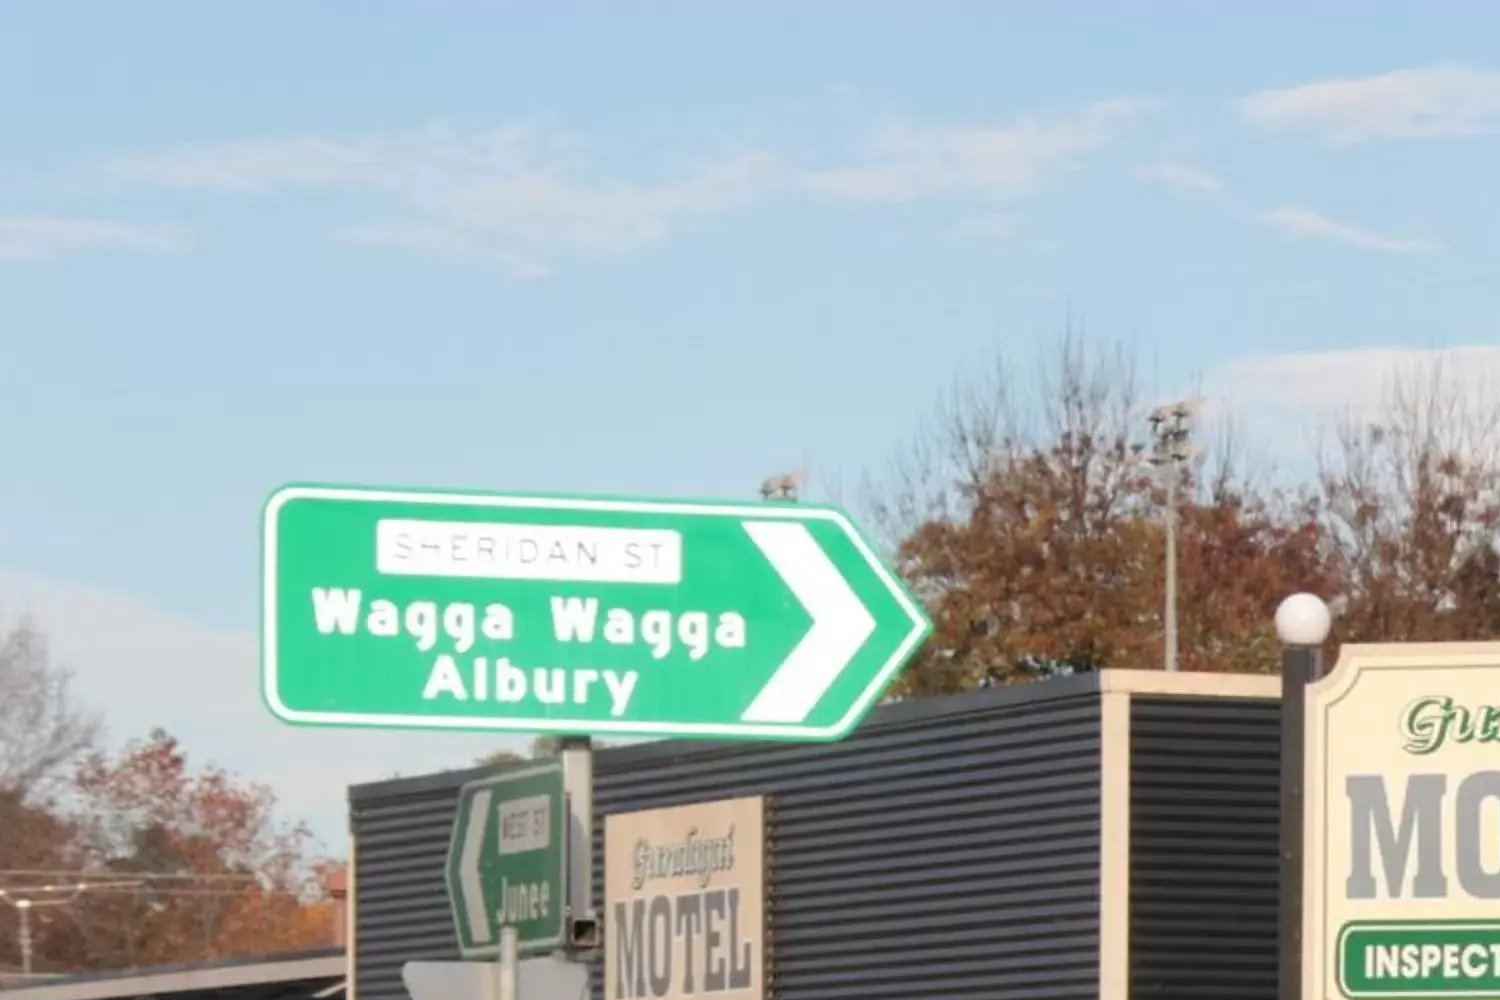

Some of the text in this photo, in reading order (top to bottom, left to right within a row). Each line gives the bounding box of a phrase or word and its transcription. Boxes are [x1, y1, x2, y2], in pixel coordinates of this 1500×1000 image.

[393, 531, 666, 571] SHERIDAN ST
[311, 586, 747, 660] Wagga Wagga
[421, 654, 639, 717] Albury
[630, 824, 736, 890] Gundagai
[496, 876, 550, 924] Junee
[614, 888, 752, 1000] MOTEL
